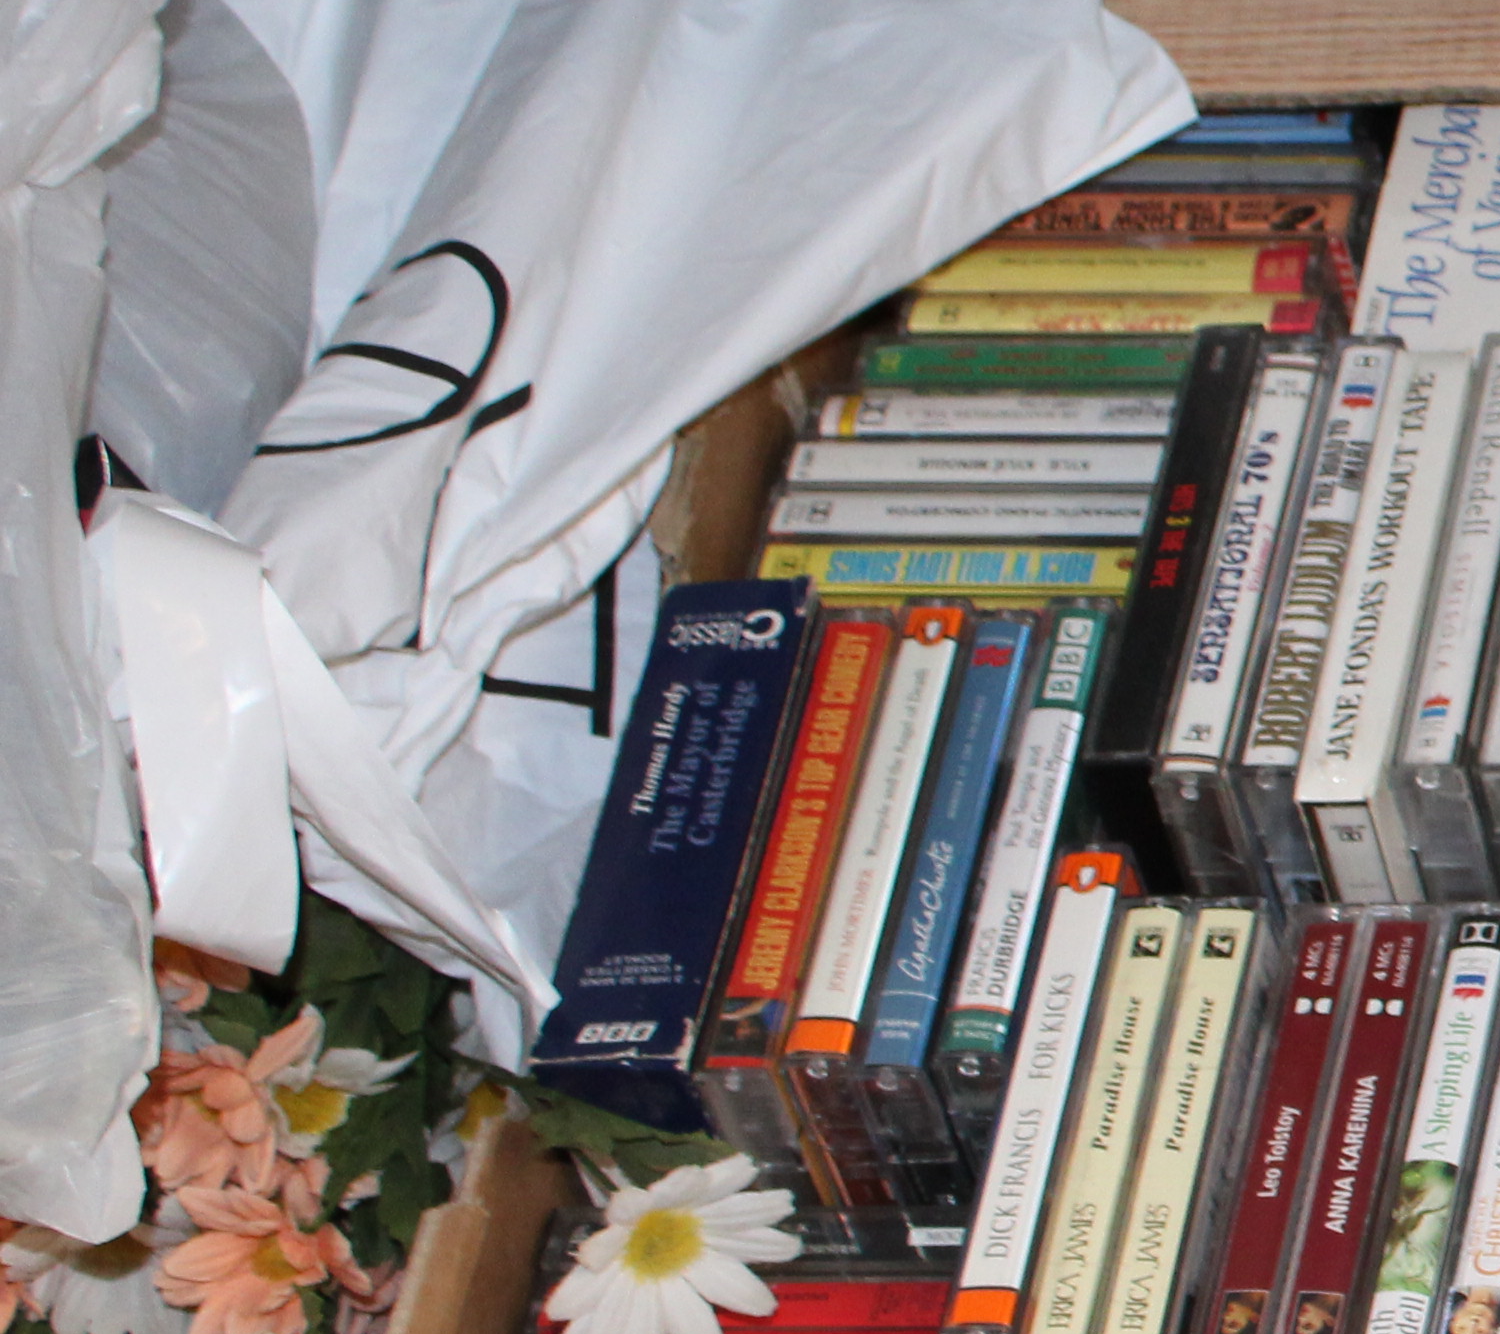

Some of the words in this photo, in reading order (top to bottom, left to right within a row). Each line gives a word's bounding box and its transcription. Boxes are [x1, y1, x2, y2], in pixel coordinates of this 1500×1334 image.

[1376, 254, 1450, 335] The
[1401, 372, 1437, 436] TAPE
[1368, 446, 1419, 573] WORKOUT
[1188, 493, 1262, 684] SENSATIONAL
[1241, 431, 1279, 486] 70's
[1284, 520, 1352, 622] LUDLUM
[832, 631, 873, 704] COMEDY
[1044, 618, 1094, 699] BBC
[1343, 580, 1389, 690] FONDA'S
[1253, 629, 1327, 750] ROBERT
[630, 746, 672, 816] Thomas
[652, 681, 691, 743] Hardy
[664, 713, 713, 798] Mayor
[686, 678, 757, 847] Casterbridge
[808, 706, 852, 755] GEAR
[1327, 694, 1361, 760] JANE
[797, 760, 836, 794] TOP
[762, 795, 826, 914] CLARKSON'S
[743, 916, 795, 990] JEREMY
[965, 928, 998, 997] FRANCIS
[986, 890, 1029, 998] DURBRIDGE
[1039, 972, 1077, 1034] KICKS
[1114, 995, 1144, 1061] House
[1185, 995, 1216, 1061] House
[1028, 1036, 1062, 1081] FOR
[1428, 1049, 1464, 1136] Sleeping
[1449, 1009, 1475, 1046] Life
[1091, 1065, 1132, 1153] Paradise
[1164, 1065, 1203, 1154] Paradise
[1262, 1105, 1301, 1164] Tolstoy
[1337, 1075, 1378, 1171] KARENINA
[999, 1106, 1043, 1201] FRANCIS
[1256, 1166, 1279, 1199] Leo
[984, 1204, 1027, 1260] DICK
[1059, 1201, 1098, 1265] JAMES
[1133, 1202, 1171, 1266] JAMES
[1324, 1175, 1355, 1234] ANNA
[1046, 1271, 1085, 1332] ERICA
[1121, 1272, 1159, 1333] ERICA
